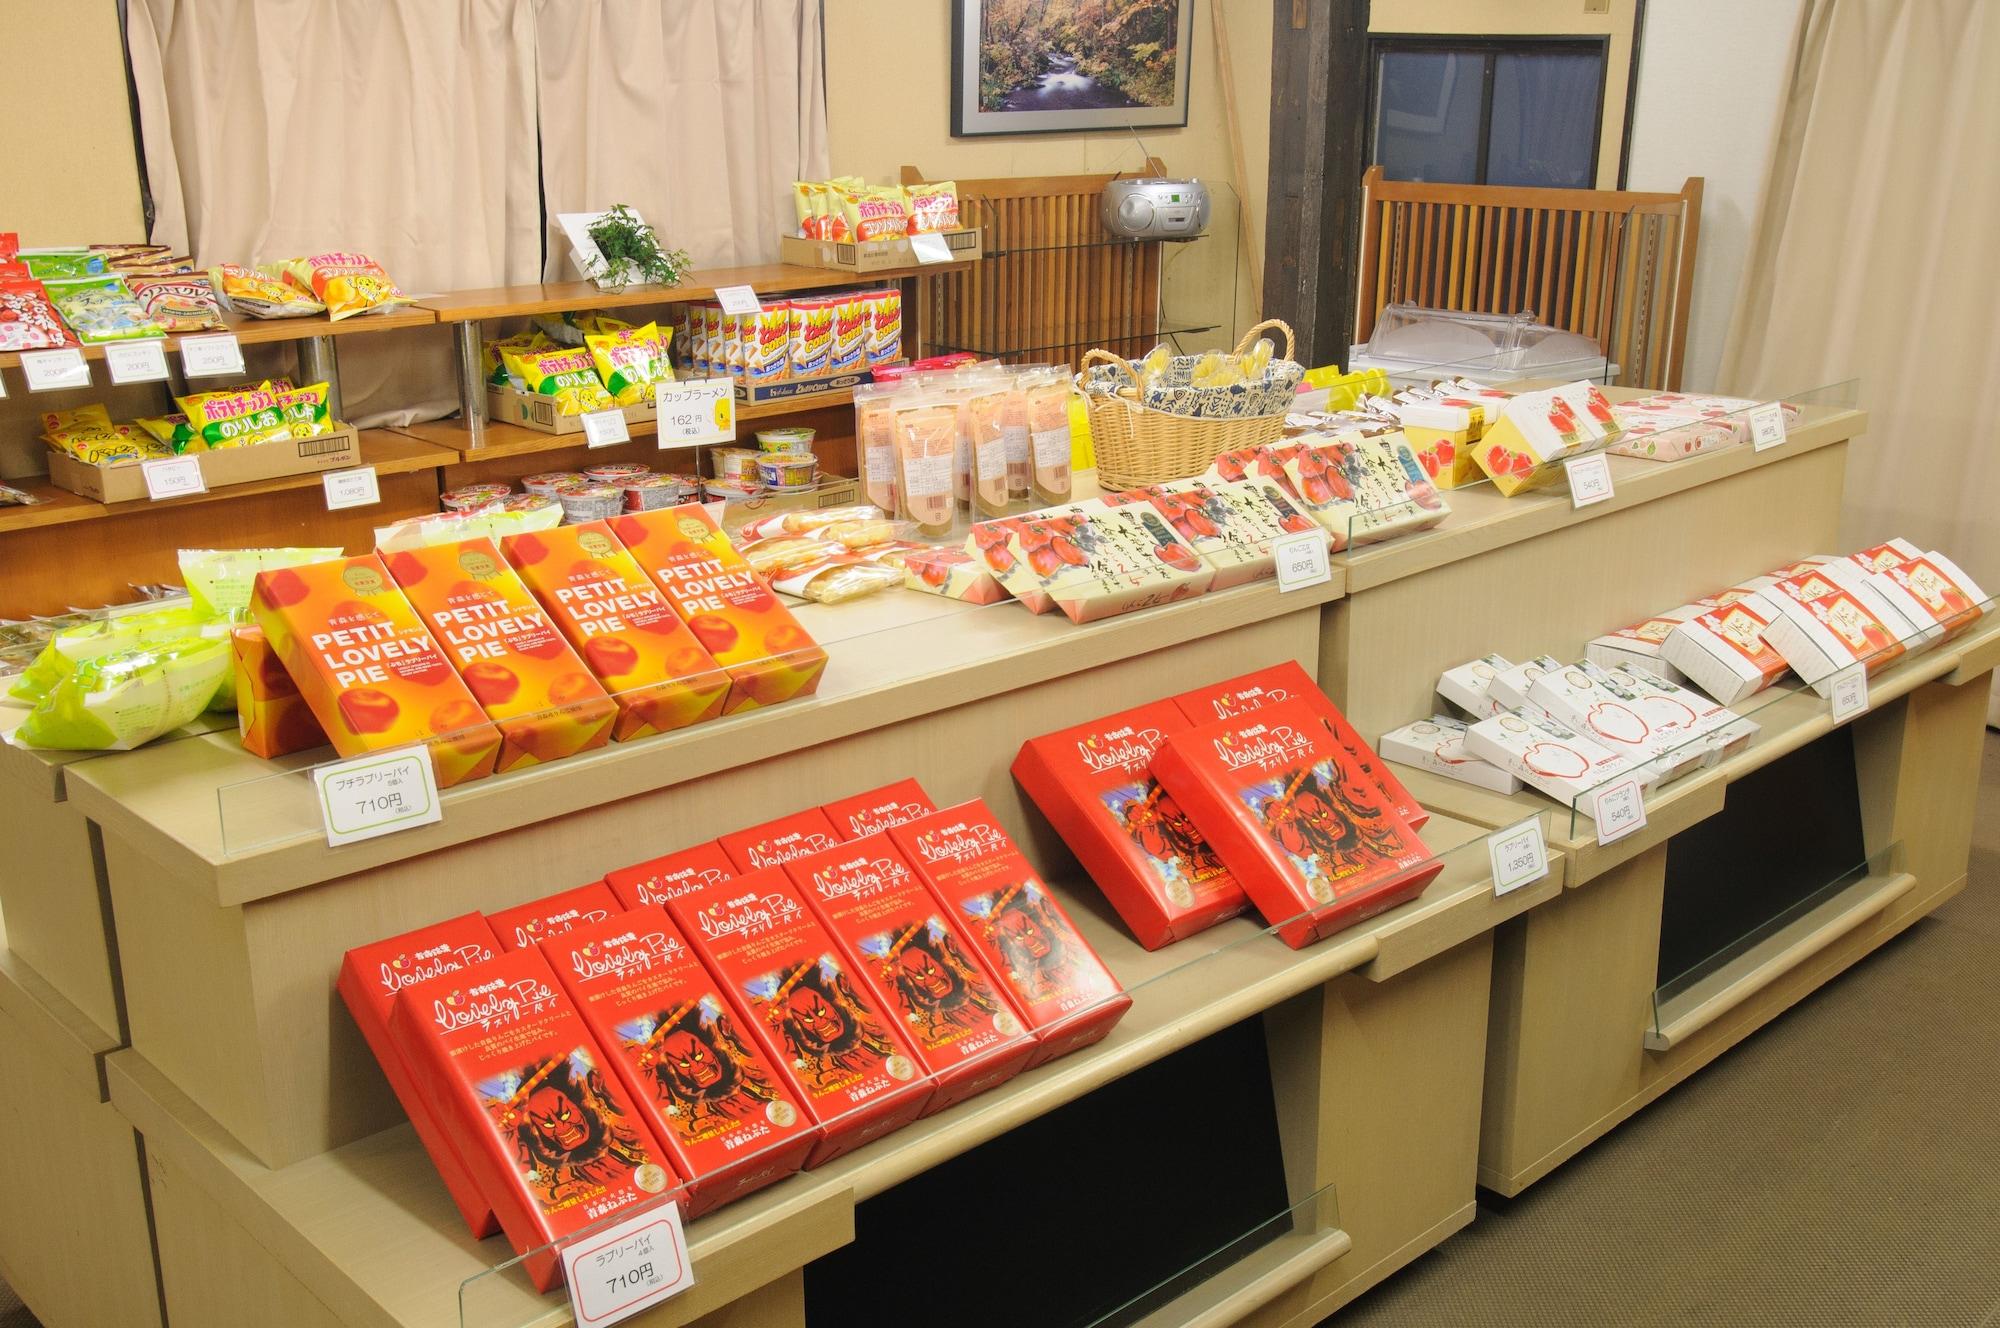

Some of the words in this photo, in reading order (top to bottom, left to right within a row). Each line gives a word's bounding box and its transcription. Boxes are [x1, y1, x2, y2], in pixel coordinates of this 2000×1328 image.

[556, 369, 600, 388] のりしお
[204, 390, 275, 421] ポテトチップス
[663, 385, 729, 404] カップラーメン
[220, 412, 281, 438] のりしお
[656, 559, 725, 584] PETIT
[1292, 558, 1314, 574] 650円
[554, 577, 628, 604] PETIT
[669, 569, 755, 600] LOVELY
[432, 599, 512, 628] PETIT
[567, 589, 659, 621] LOVELY
[682, 594, 726, 616] PIE
[311, 620, 396, 651] PETIT
[444, 612, 545, 646] LOVELY
[579, 615, 627, 637] PIE
[323, 634, 431, 670] LOVELY
[458, 640, 509, 663] PIE
[335, 664, 390, 689] PIE
[1213, 736, 1289, 768] Lovely
[1270, 726, 1308, 748] Pie
[356, 792, 404, 815] 710円
[1611, 805, 1632, 822] 540円
[917, 833, 983, 861] Lovely
[969, 823, 1003, 843] Pie
[1507, 852, 1535, 873] 1,350円
[813, 868, 883, 898] Lovely
[870, 858, 905, 879] Pie
[698, 905, 773, 937] Lovely
[760, 893, 798, 915] Pie
[572, 946, 652, 978] Lovely
[639, 932, 680, 955] Pie
[434, 993, 520, 1030] Lovely
[509, 978, 552, 1003] Pie
[724, 1125, 772, 1151] 青森ねぶた
[586, 1191, 639, 1220] 青森ねぶた
[596, 1233, 652, 1268] ラブリーパイ
[605, 1261, 655, 1294] 710円
